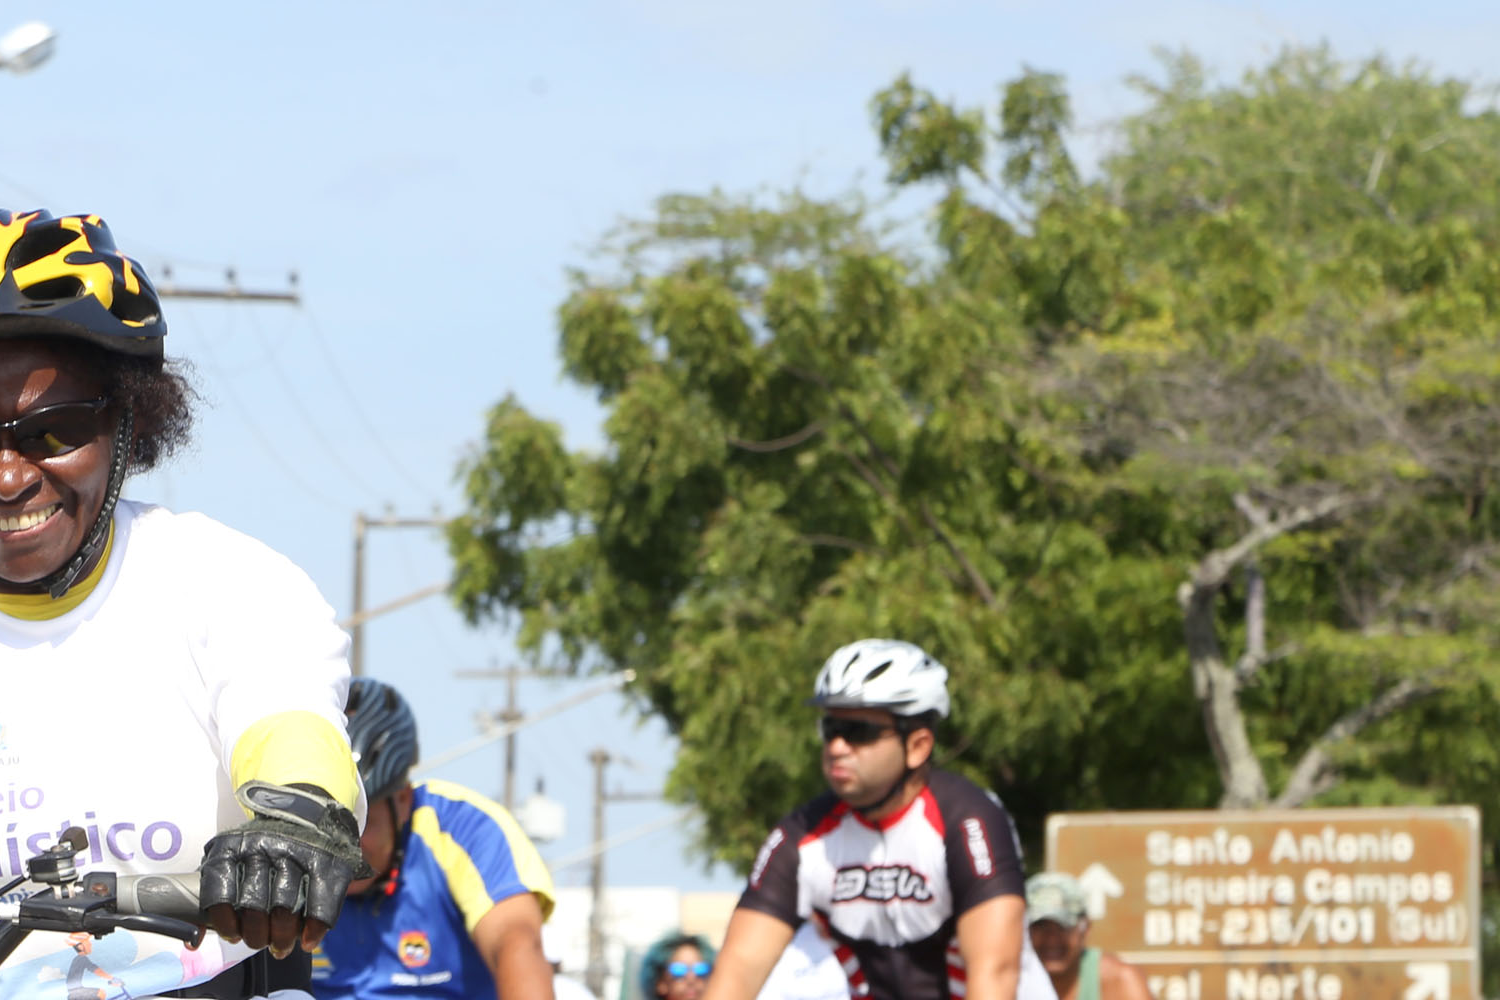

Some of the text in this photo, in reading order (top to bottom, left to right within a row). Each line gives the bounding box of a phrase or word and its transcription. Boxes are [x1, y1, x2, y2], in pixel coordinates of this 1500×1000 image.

[1145, 825, 1415, 866] Santo Antonio
[1144, 867, 1454, 912] Siqueira Campos
[1387, 905, 1468, 946] (Sul)
